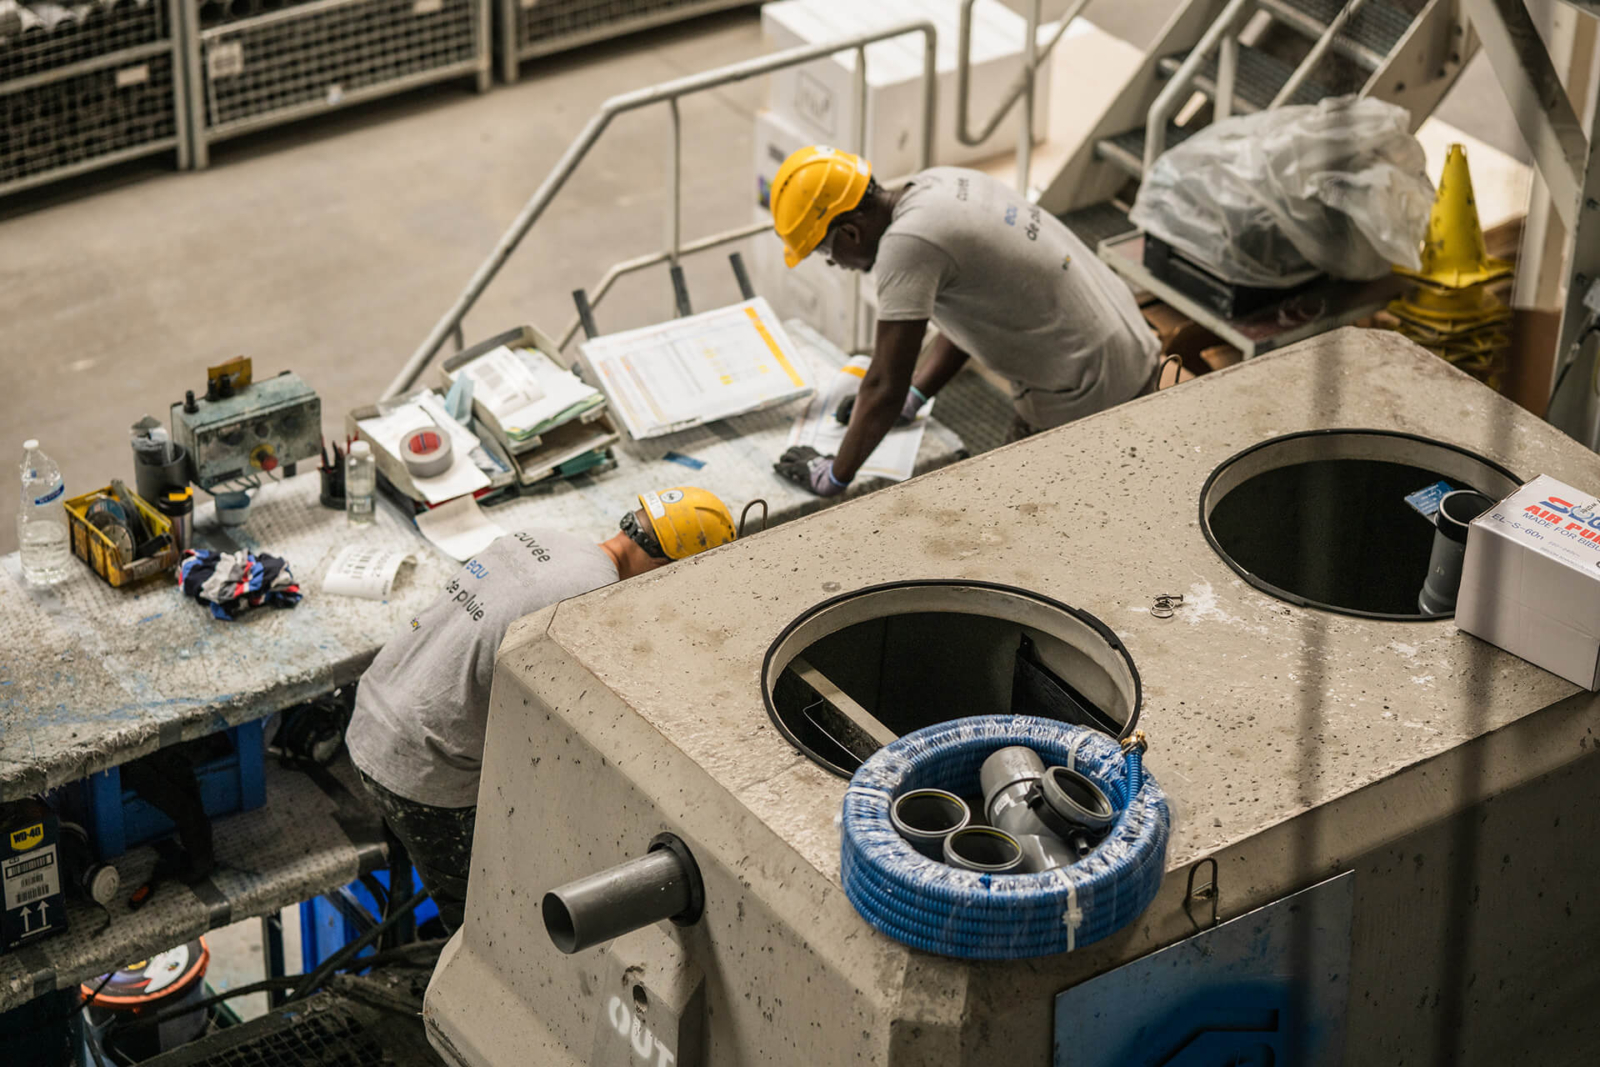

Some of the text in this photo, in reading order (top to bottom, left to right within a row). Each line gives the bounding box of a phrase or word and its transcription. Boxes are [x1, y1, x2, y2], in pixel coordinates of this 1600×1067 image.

[1522, 512, 1553, 529] MADE
[1554, 526, 1577, 540] FOR
[1523, 504, 1564, 525] AIR
[514, 531, 551, 563] cuvée
[466, 559, 489, 579] eau
[452, 589, 485, 622] pluie
[13, 826, 41, 844] WD-40
